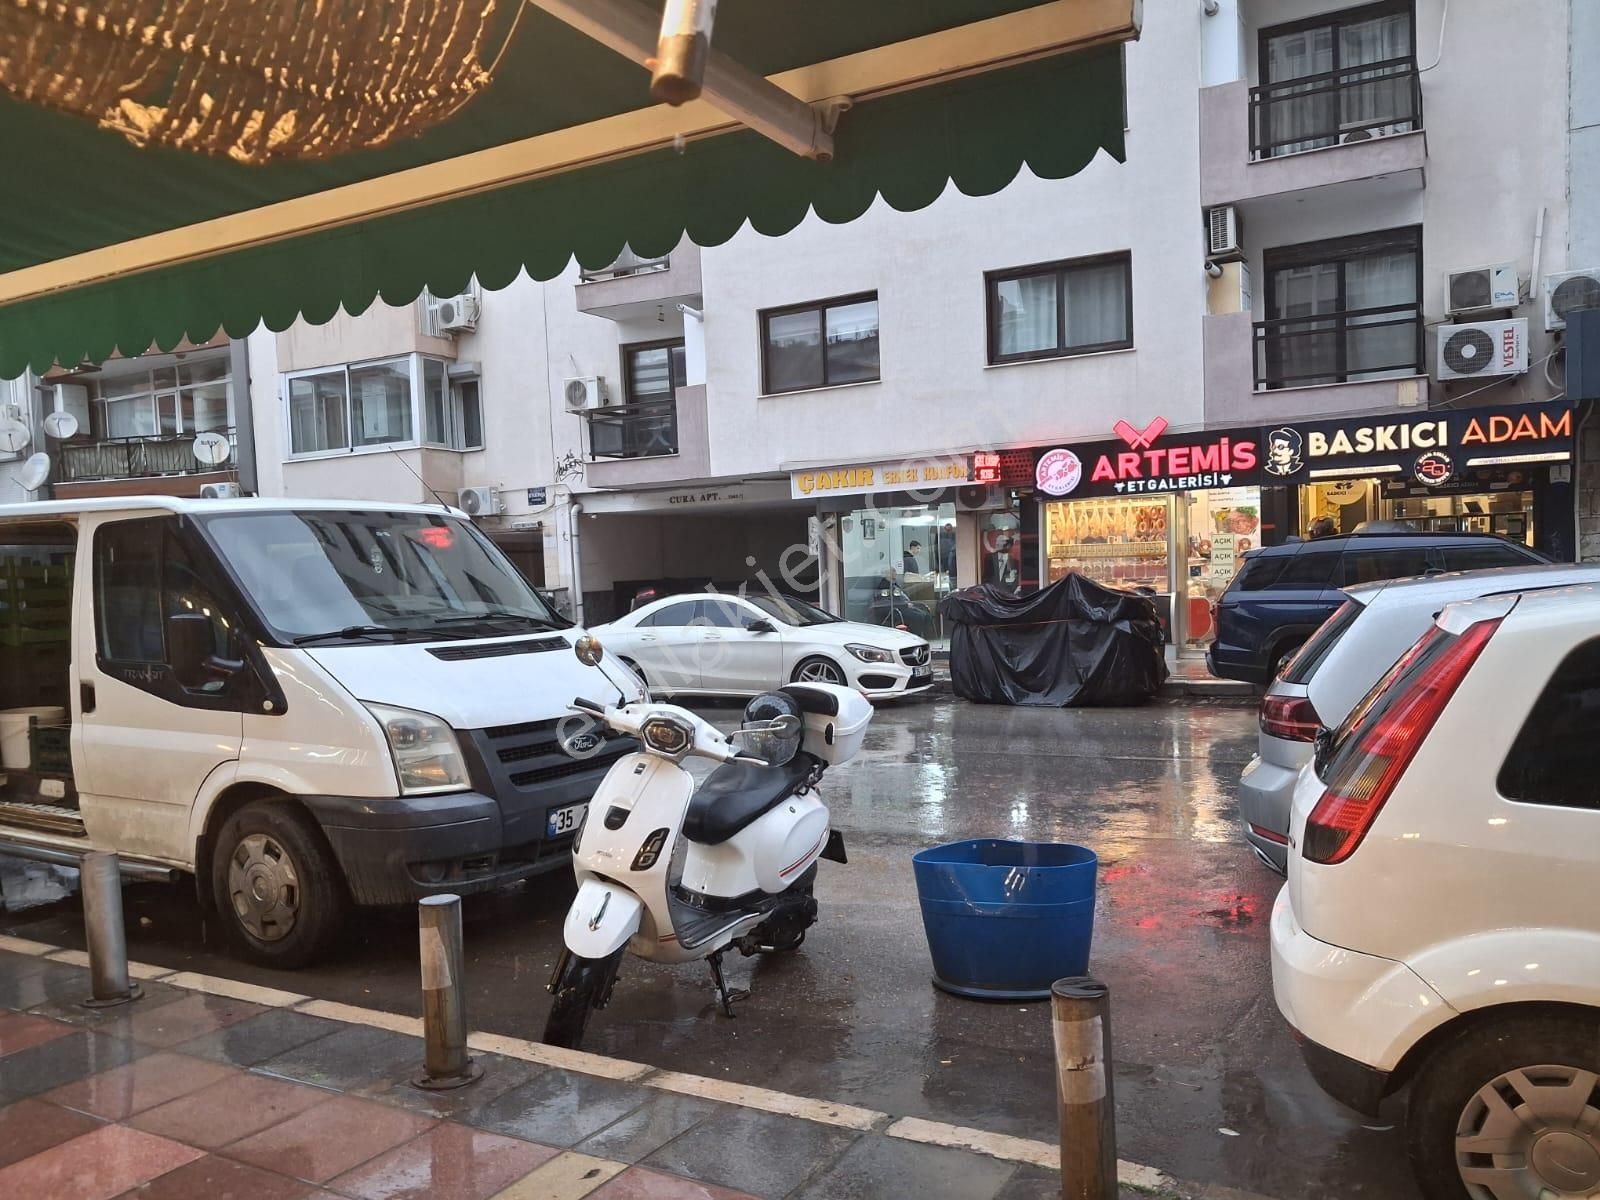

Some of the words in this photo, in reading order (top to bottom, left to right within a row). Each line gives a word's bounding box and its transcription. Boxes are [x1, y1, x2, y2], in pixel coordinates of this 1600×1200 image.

[1503, 326, 1514, 368] VESTEL
[1308, 420, 1448, 457] BASKICI
[1461, 409, 1571, 445] ADAM
[1091, 437, 1256, 481] ARTEMİS
[798, 467, 875, 494] ÇAKIR
[1127, 480, 1144, 493] ET
[1149, 472, 1218, 491] GALERİSİ
[1214, 537, 1232, 545] AÇIK
[1214, 552, 1232, 561] AÇIK
[1214, 568, 1232, 576] AÇIK
[574, 736, 594, 750] Ford
[558, 809, 573, 830] 35
